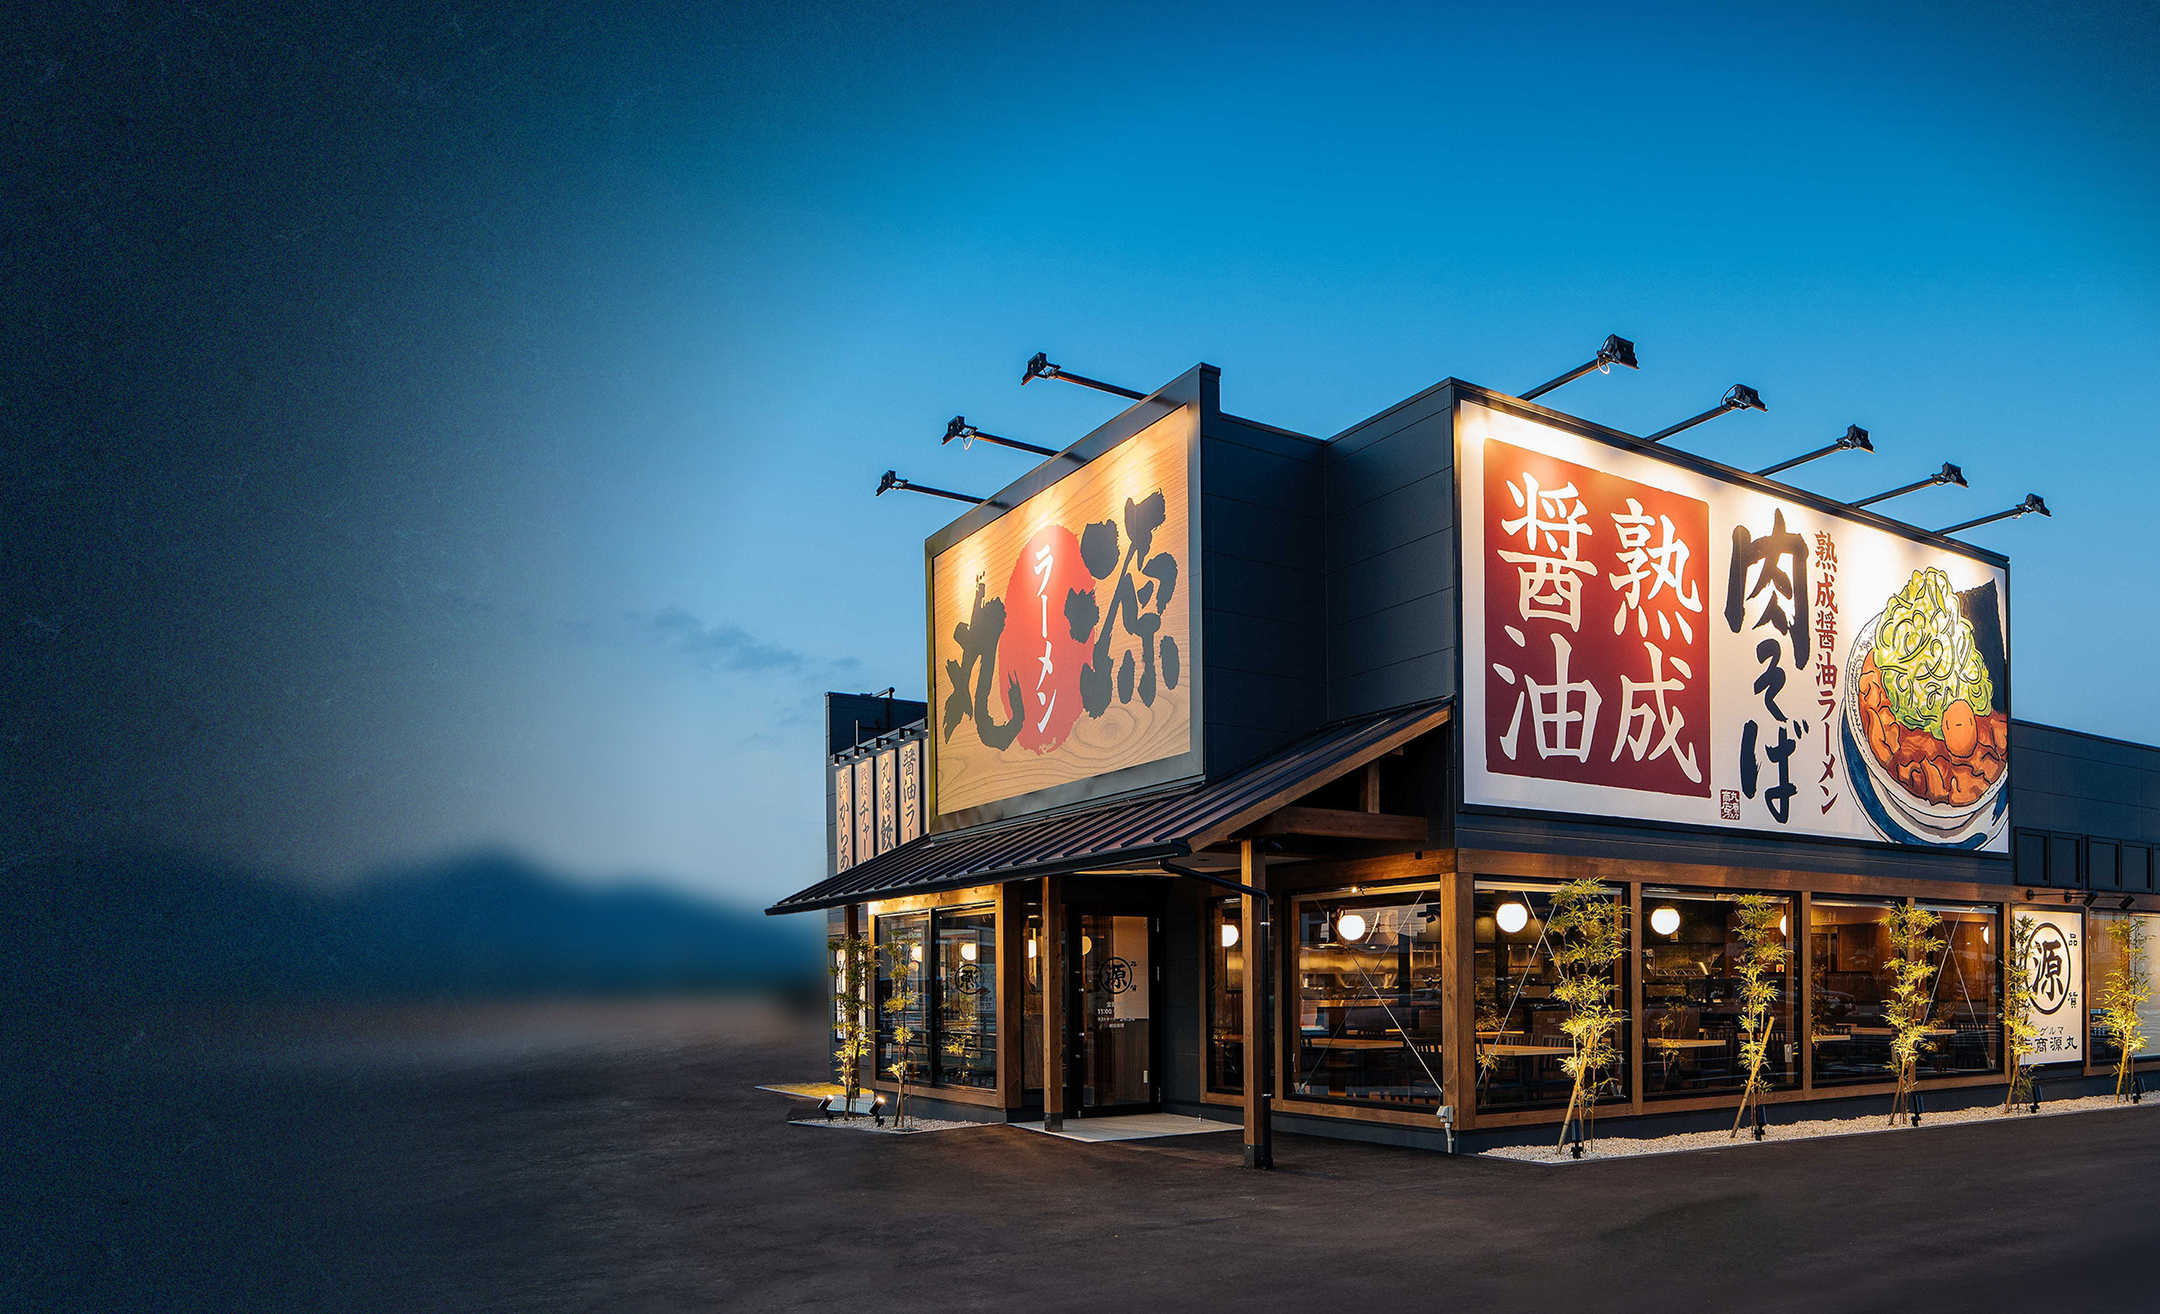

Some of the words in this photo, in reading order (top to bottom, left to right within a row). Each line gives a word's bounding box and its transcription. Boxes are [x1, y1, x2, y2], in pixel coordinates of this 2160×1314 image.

[1033, 544, 1056, 733] ラーメン
[1492, 472, 1602, 763] 醤油
[1609, 498, 1702, 783] 熟成
[1724, 508, 1810, 824] 肉そば
[1815, 530, 1838, 815] 熟成醤油ラーメン
[1105, 964, 1127, 989] 源
[2032, 939, 2063, 1001] 源
